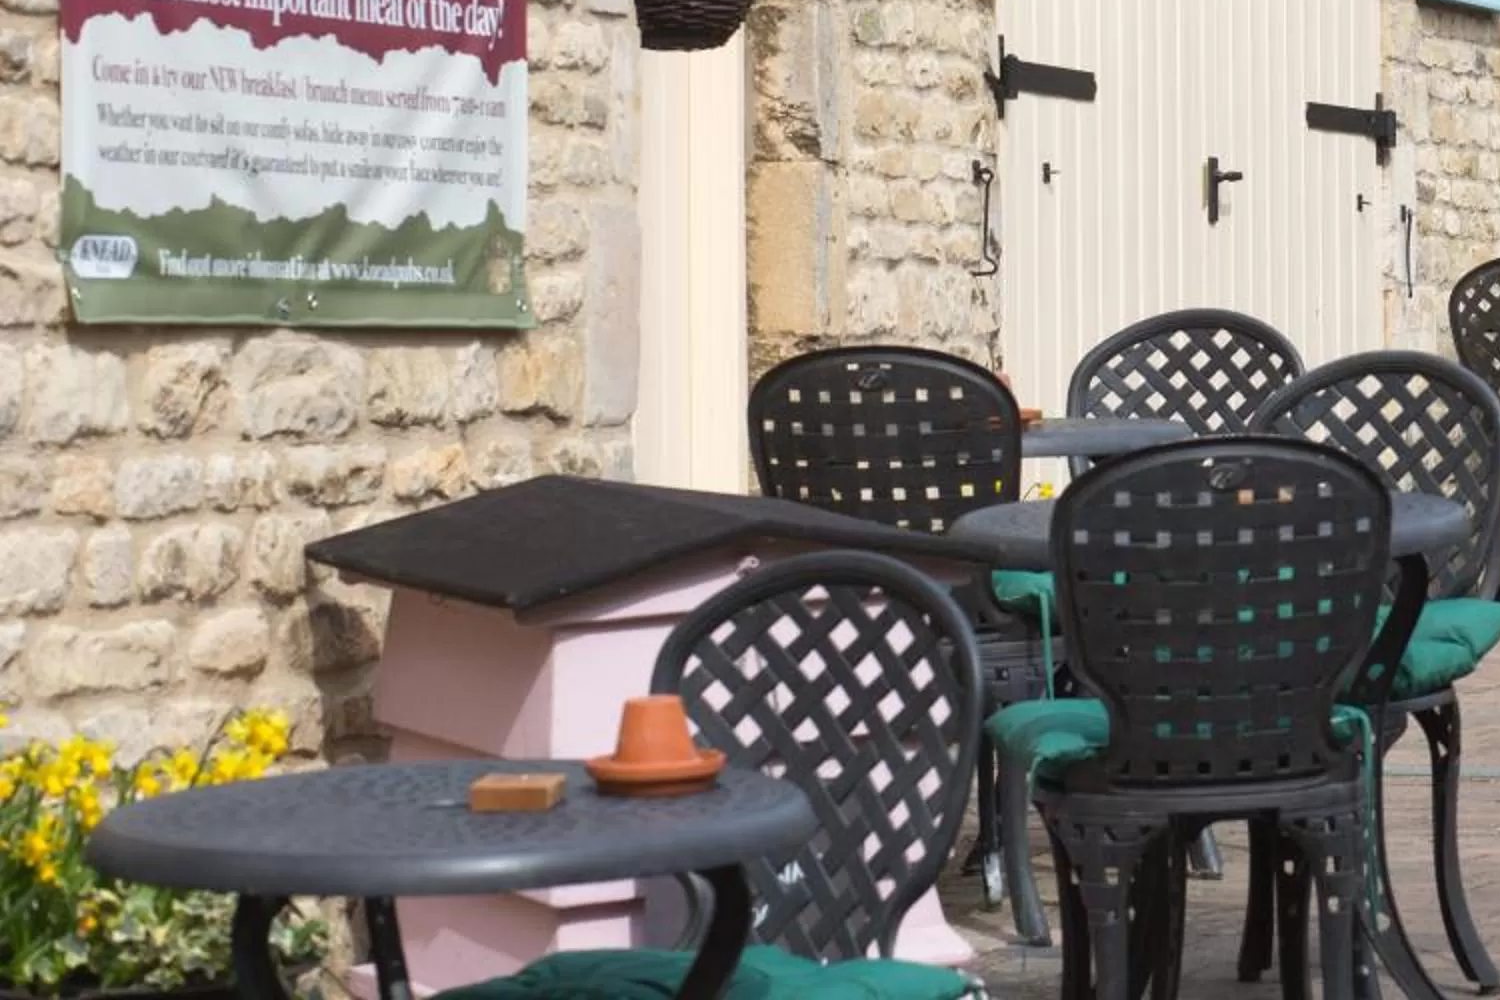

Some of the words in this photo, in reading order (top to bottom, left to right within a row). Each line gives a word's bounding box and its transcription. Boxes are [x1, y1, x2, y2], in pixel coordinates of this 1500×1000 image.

[93, 54, 131, 85] Come
[134, 57, 148, 86] in
[180, 68, 207, 91] our
[208, 65, 238, 92] NEW
[241, 69, 298, 100] breakfast
[305, 77, 348, 103] brunch
[350, 88, 385, 107] menu
[386, 86, 420, 110] served
[420, 87, 451, 113] from
[97, 103, 147, 128] Whether
